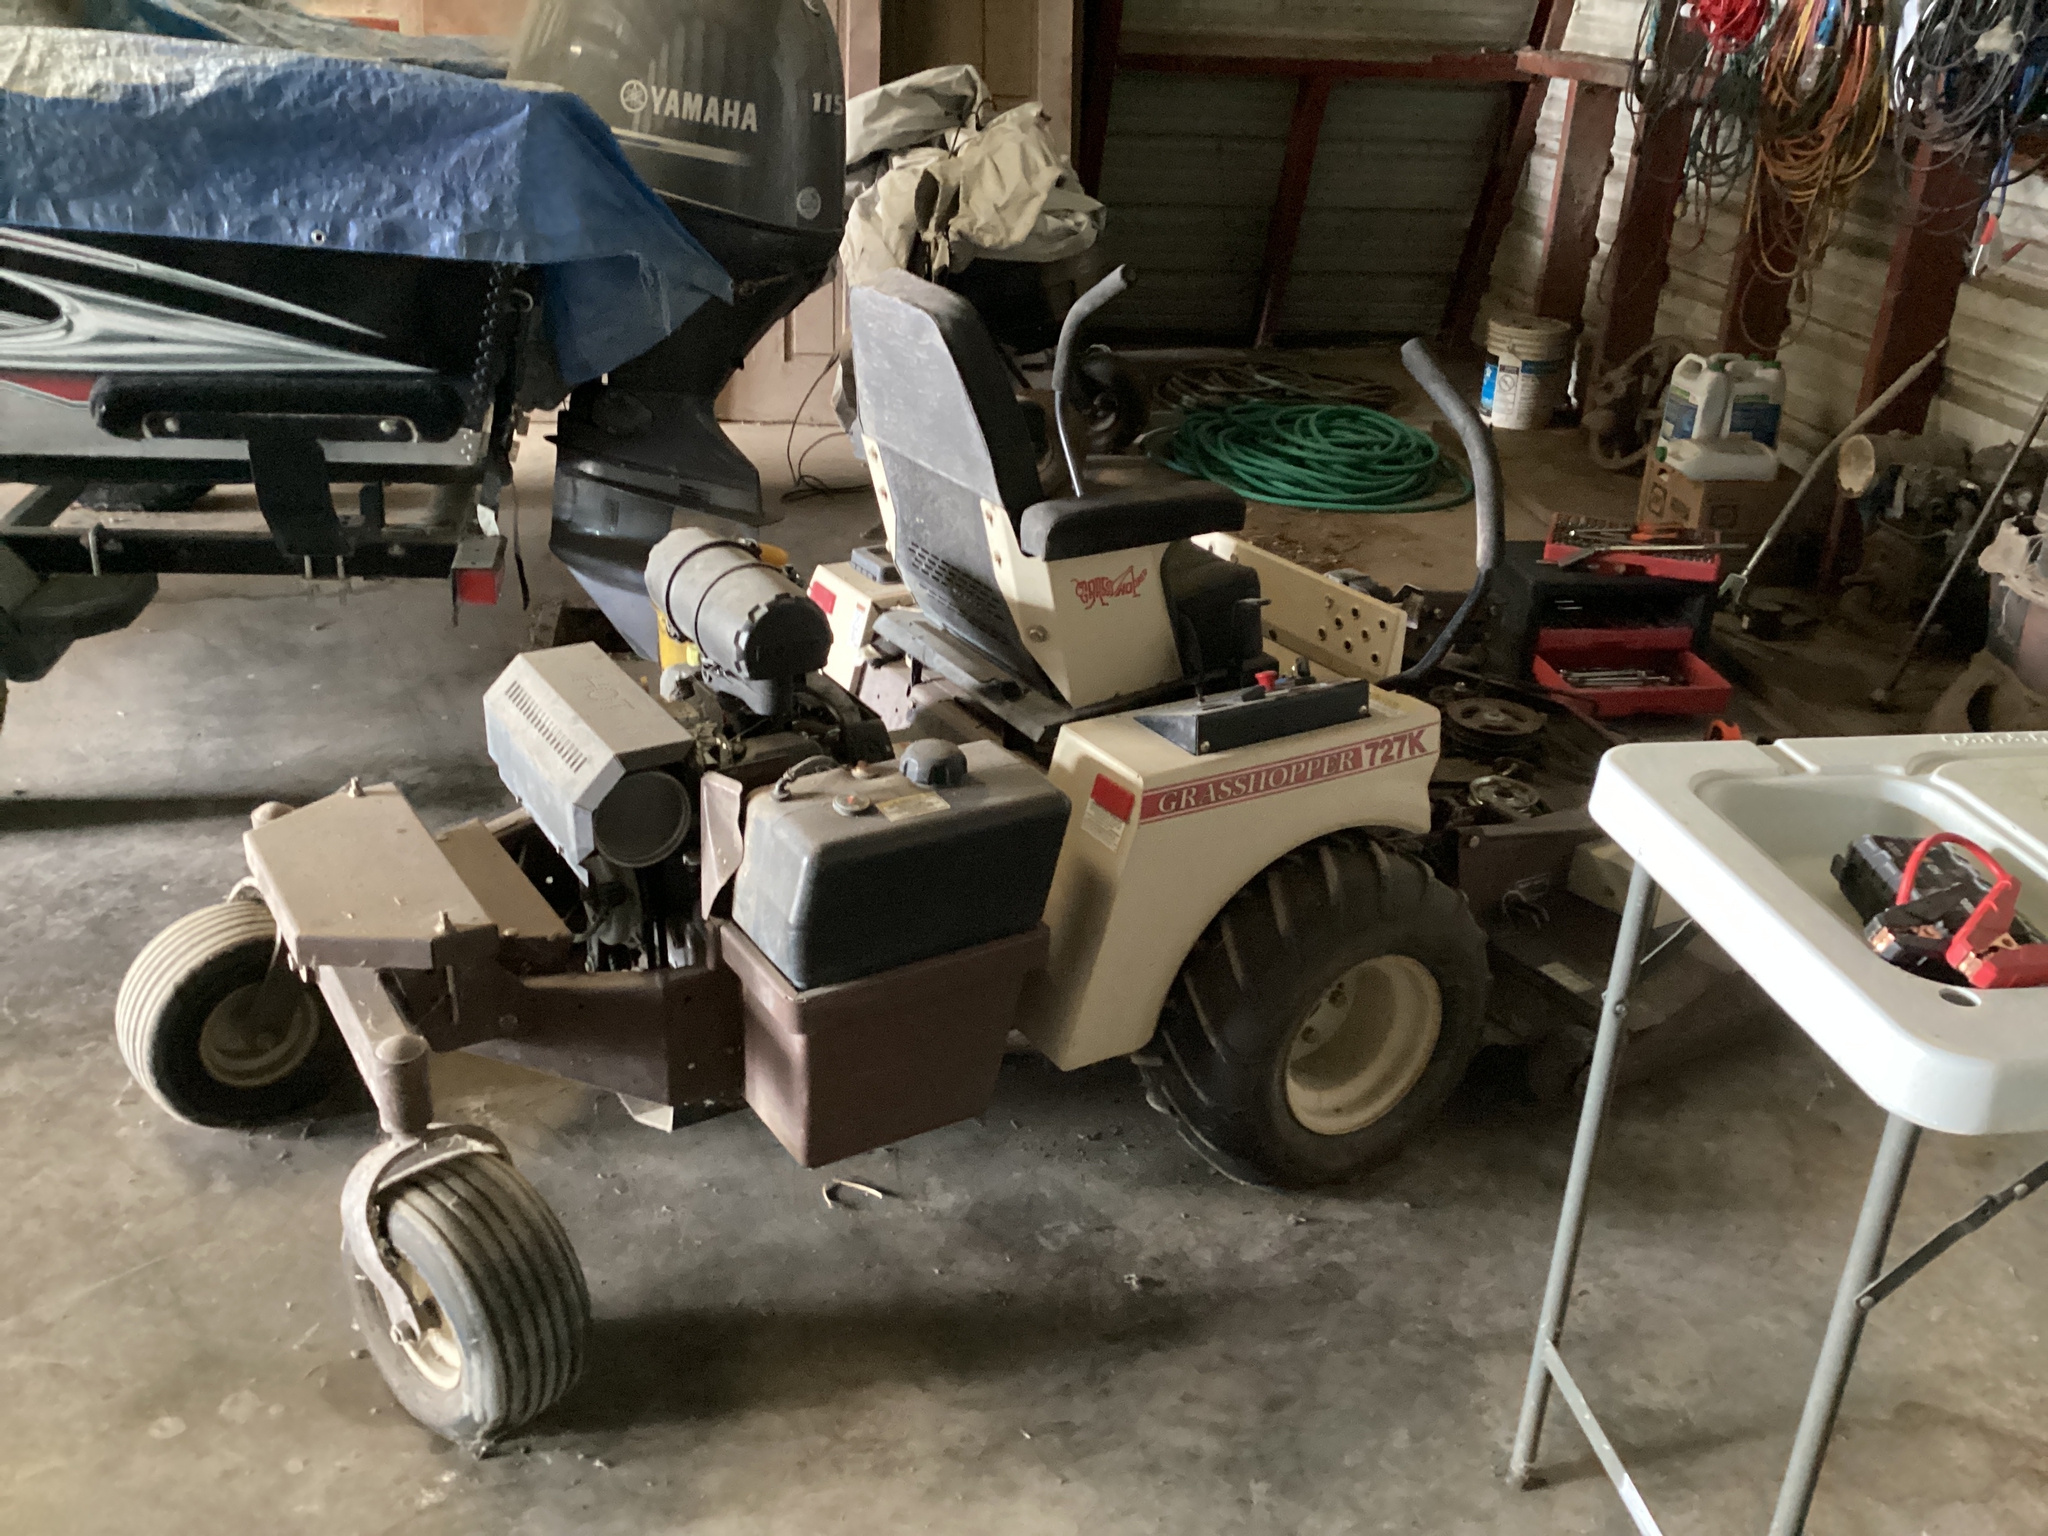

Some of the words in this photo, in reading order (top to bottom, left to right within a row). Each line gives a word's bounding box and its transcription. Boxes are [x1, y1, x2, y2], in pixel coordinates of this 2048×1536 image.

[651, 85, 758, 133] YAMAHA
[812, 91, 843, 116] 115
[1158, 750, 1355, 814] GRASSHOPPER
[1363, 729, 1428, 767] 727K
